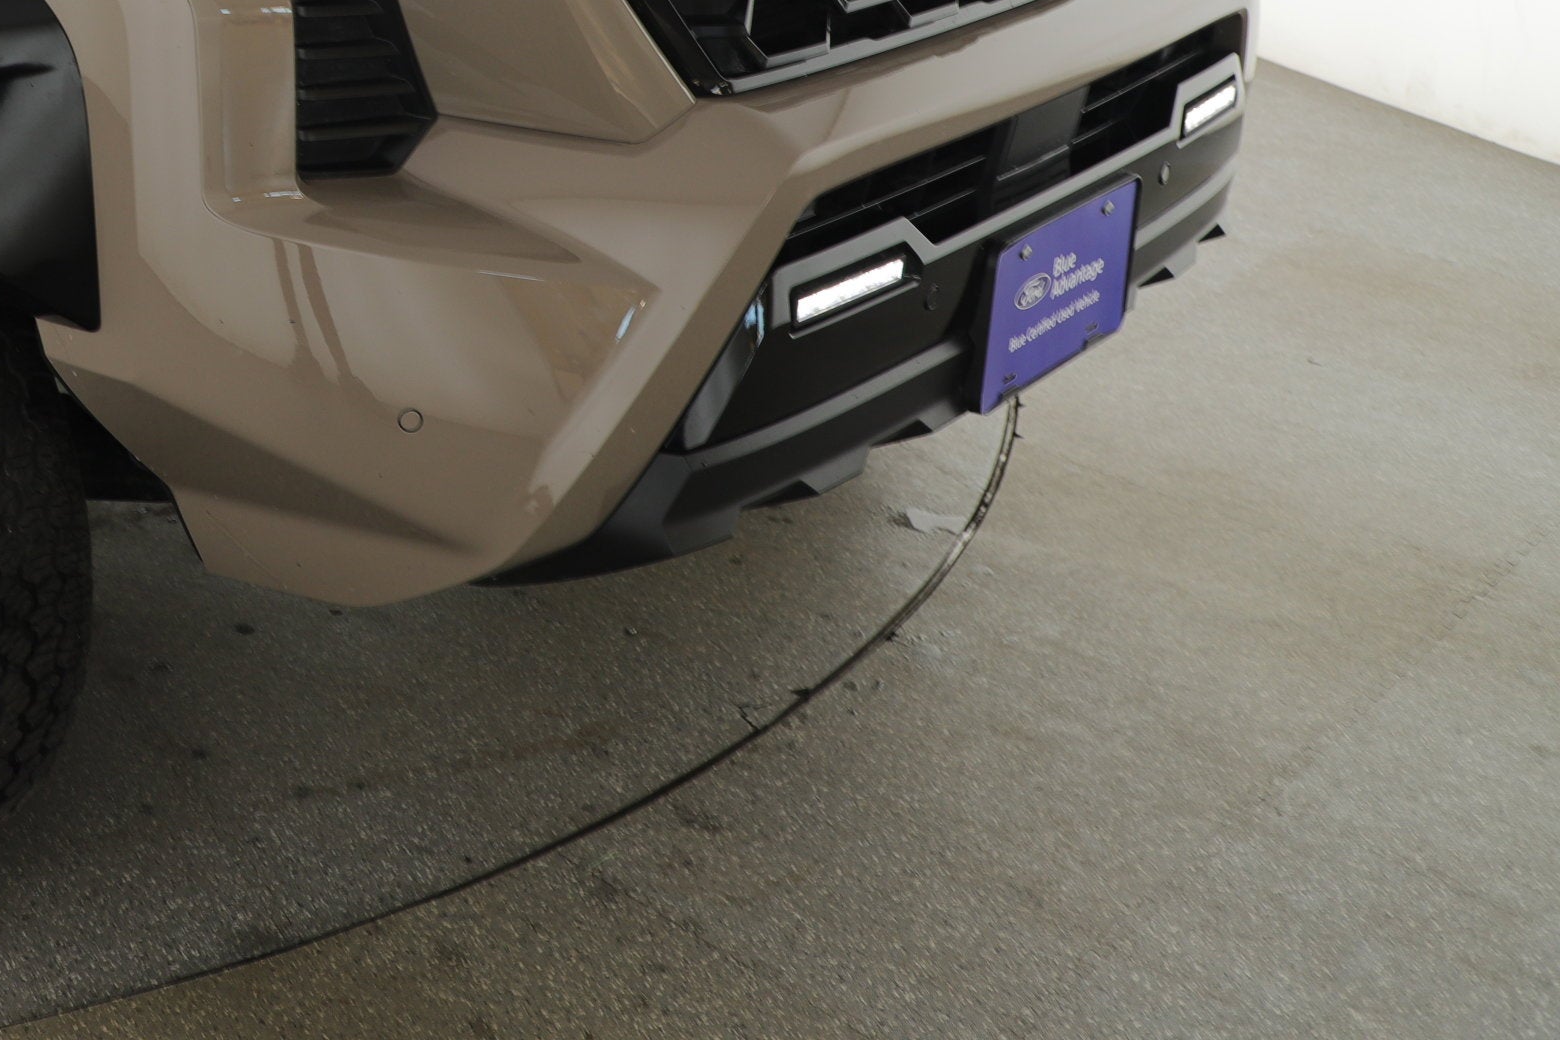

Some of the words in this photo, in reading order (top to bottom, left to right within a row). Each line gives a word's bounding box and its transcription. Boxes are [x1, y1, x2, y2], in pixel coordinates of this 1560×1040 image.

[1049, 258, 1105, 300] Advantage
[1053, 252, 1077, 278] Blue
[1008, 333, 1027, 353] Blue
[1074, 288, 1100, 312] Vehicle
